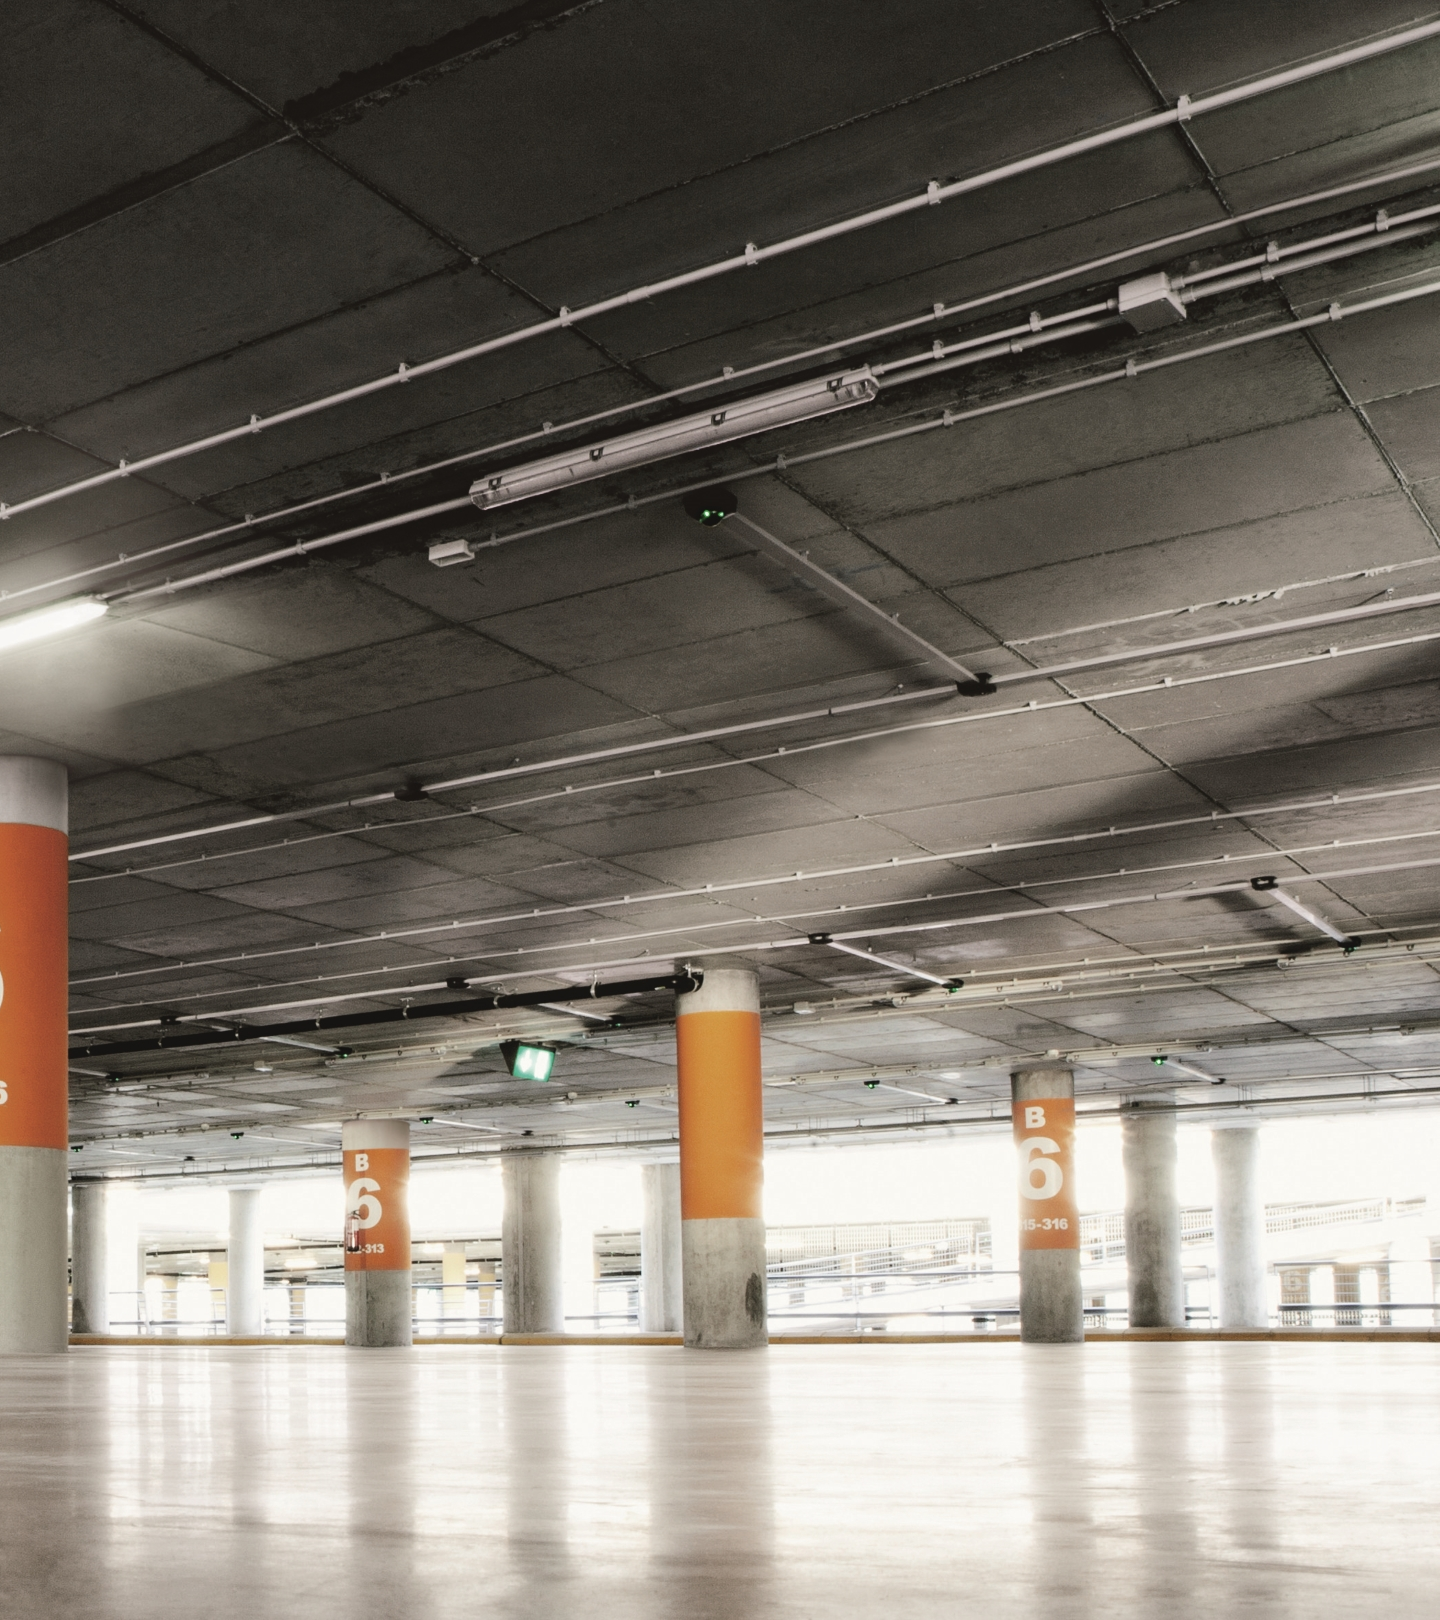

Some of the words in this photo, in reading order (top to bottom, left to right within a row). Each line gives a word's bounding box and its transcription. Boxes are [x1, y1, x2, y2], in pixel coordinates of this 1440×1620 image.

[1025, 1106, 1046, 1129] B
[355, 1153, 369, 1172] B
[1019, 1136, 1063, 1200] 6
[346, 1178, 382, 1230] 6
